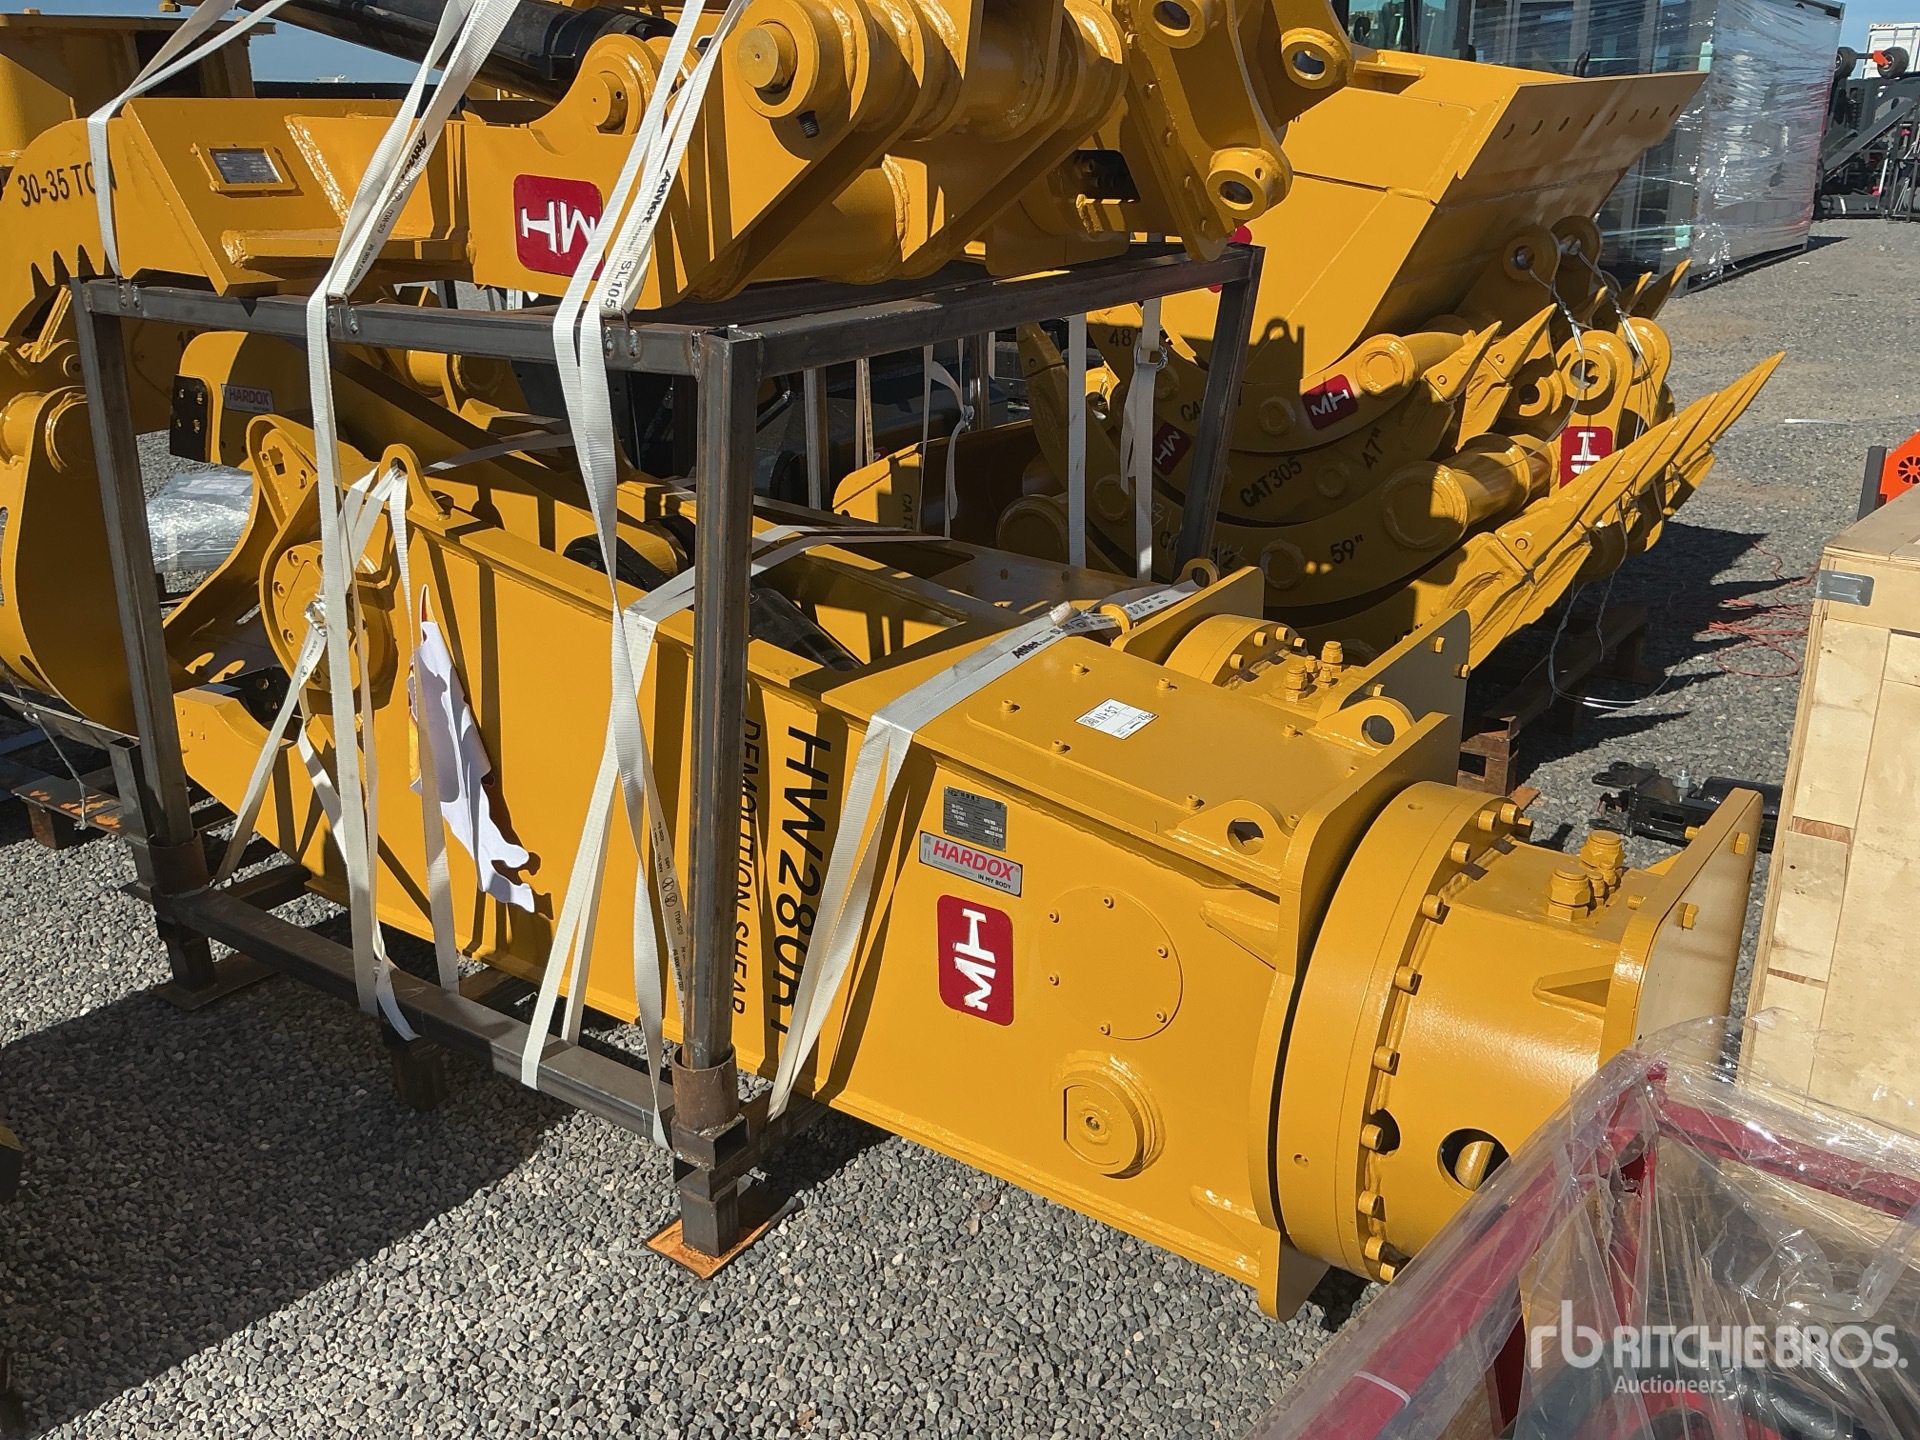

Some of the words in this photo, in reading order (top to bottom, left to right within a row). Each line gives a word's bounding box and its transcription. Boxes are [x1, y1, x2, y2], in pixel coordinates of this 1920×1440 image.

[17, 168, 70, 208] 30-35
[605, 260, 632, 309] SL105
[229, 387, 270, 407] HARDOX
[1361, 425, 1384, 470] 47"
[1239, 455, 1304, 509] CAT305
[1330, 533, 1364, 564] 59"
[736, 719, 761, 912] DEMOLITION
[933, 840, 1014, 882] HARDOX
[977, 873, 985, 881] IN
[985, 875, 996, 885] MY
[995, 878, 1011, 890] BODY
[731, 921, 750, 1015] SHEAR
